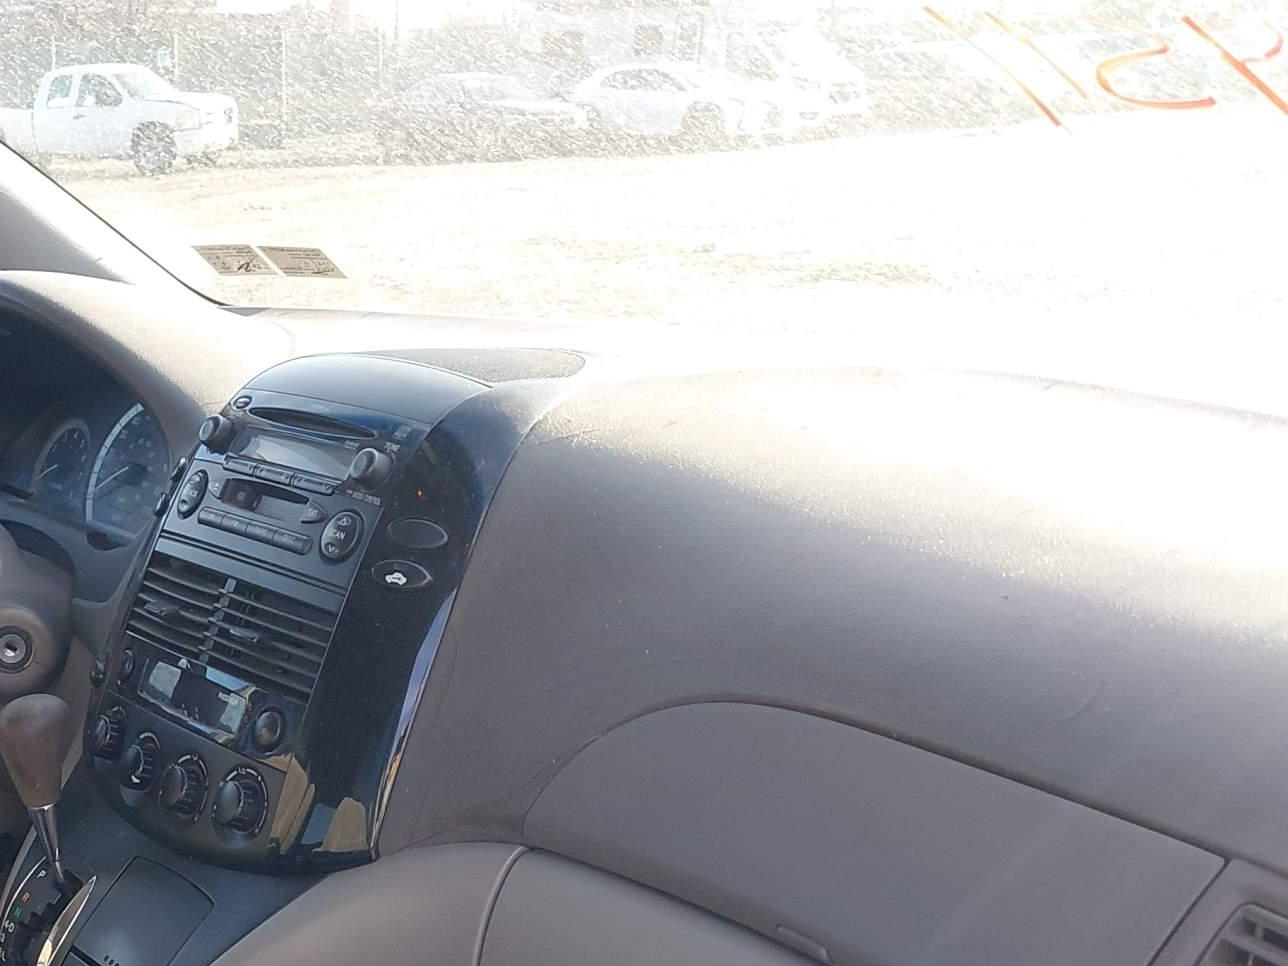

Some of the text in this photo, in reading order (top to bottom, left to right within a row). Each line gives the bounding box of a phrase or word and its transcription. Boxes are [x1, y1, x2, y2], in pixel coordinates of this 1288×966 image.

[37, 870, 46, 878] P
[22, 892, 30, 903] R
[13, 907, 23, 918] N
